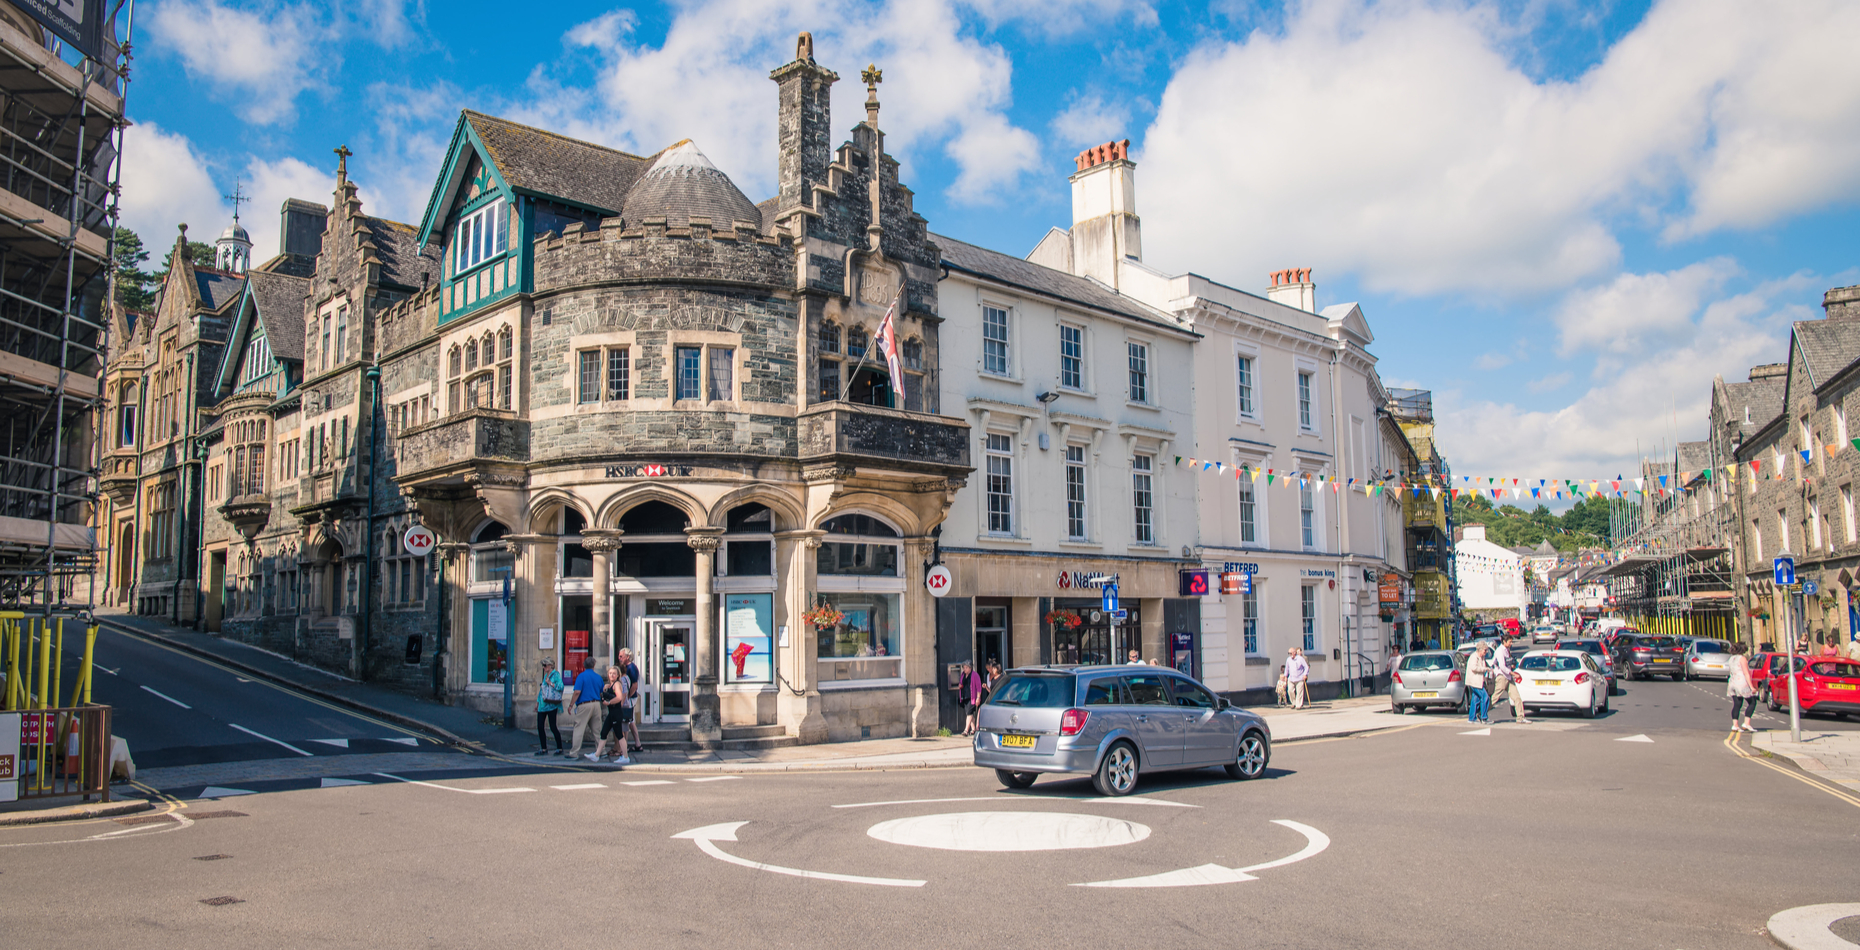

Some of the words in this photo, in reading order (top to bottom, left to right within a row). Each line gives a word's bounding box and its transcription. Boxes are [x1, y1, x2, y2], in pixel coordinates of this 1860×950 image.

[47, 10, 81, 41] Scaffolding
[866, 285, 888, 304] 1895
[605, 464, 645, 478] HSBC
[667, 464, 694, 477] UK
[1224, 562, 1259, 575] BETFRED
[1308, 568, 1323, 577] bonus
[1325, 568, 1336, 578] king
[1071, 571, 1121, 590] NatWt
